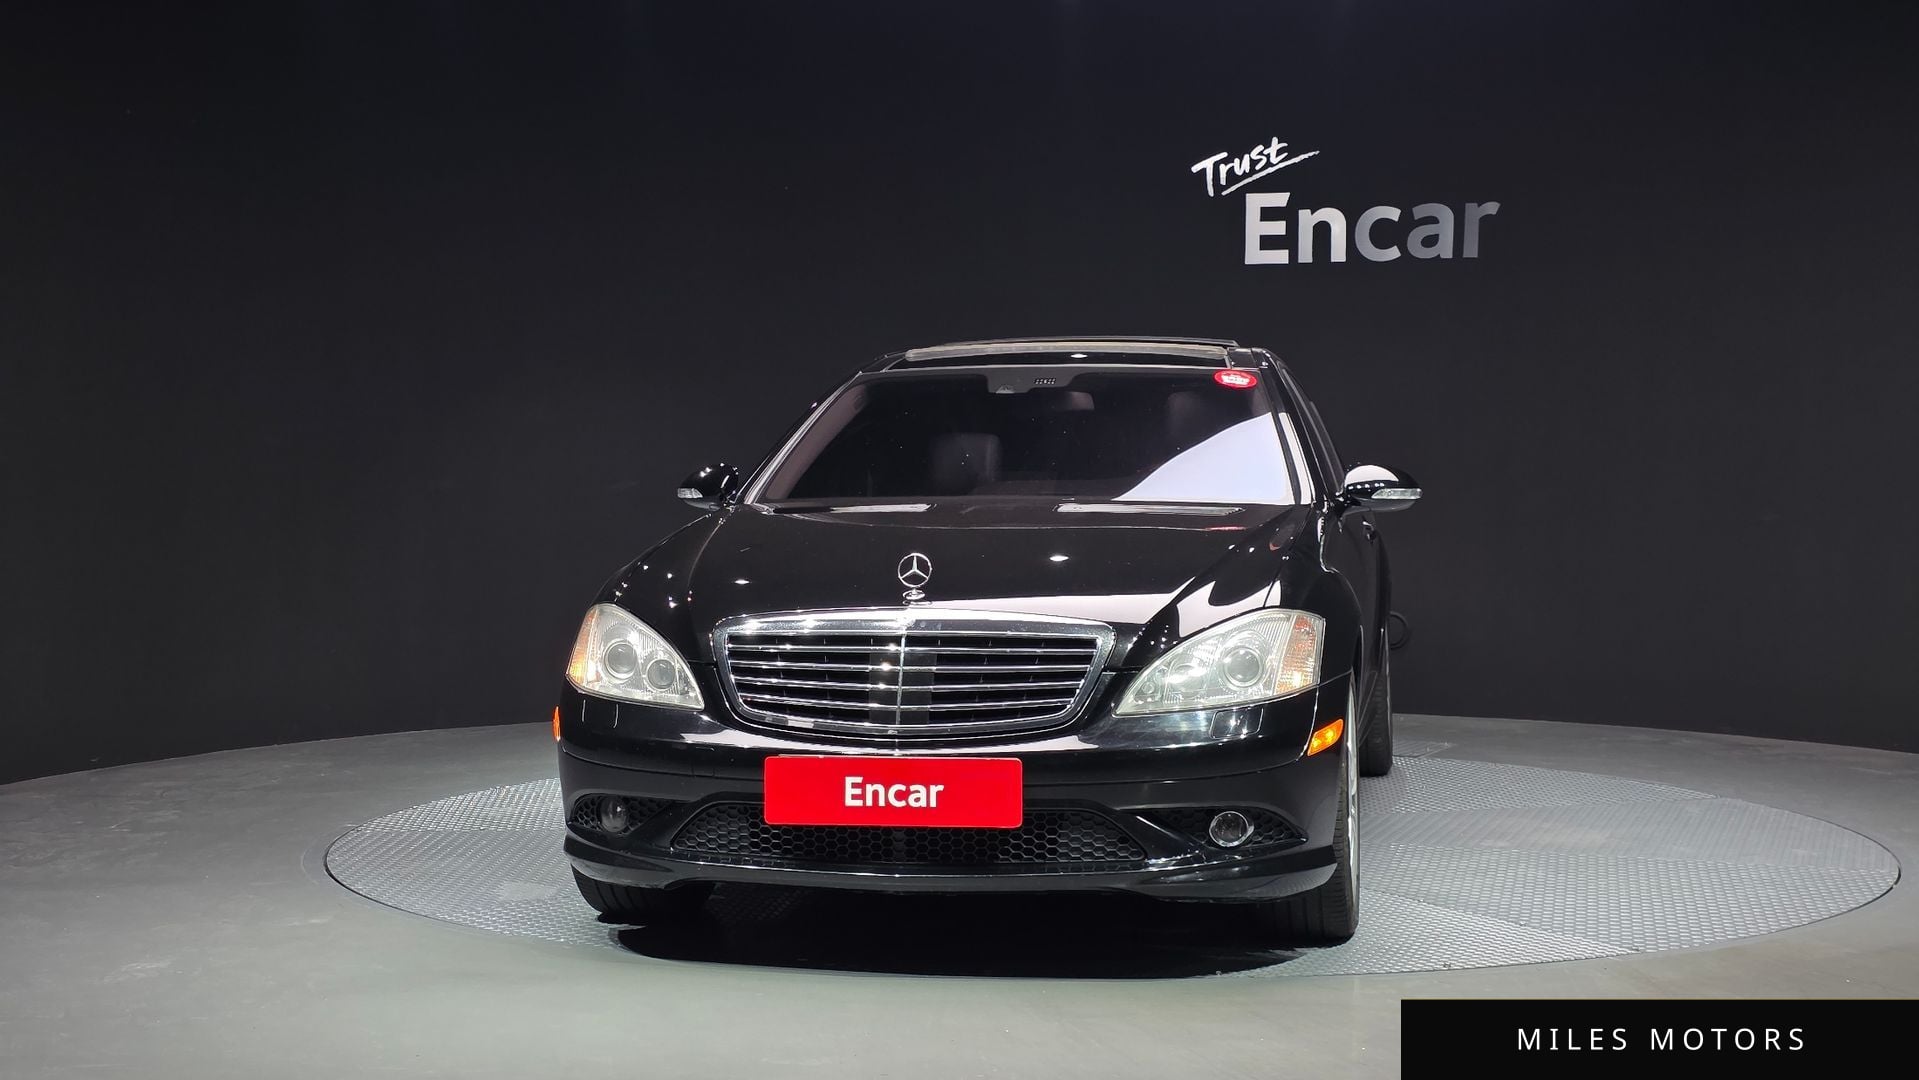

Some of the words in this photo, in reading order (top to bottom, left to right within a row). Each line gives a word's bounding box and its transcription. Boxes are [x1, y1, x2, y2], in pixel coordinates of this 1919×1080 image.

[1190, 136, 1289, 197] Trust
[1244, 191, 1501, 265] Encar
[844, 776, 945, 808] Encar
